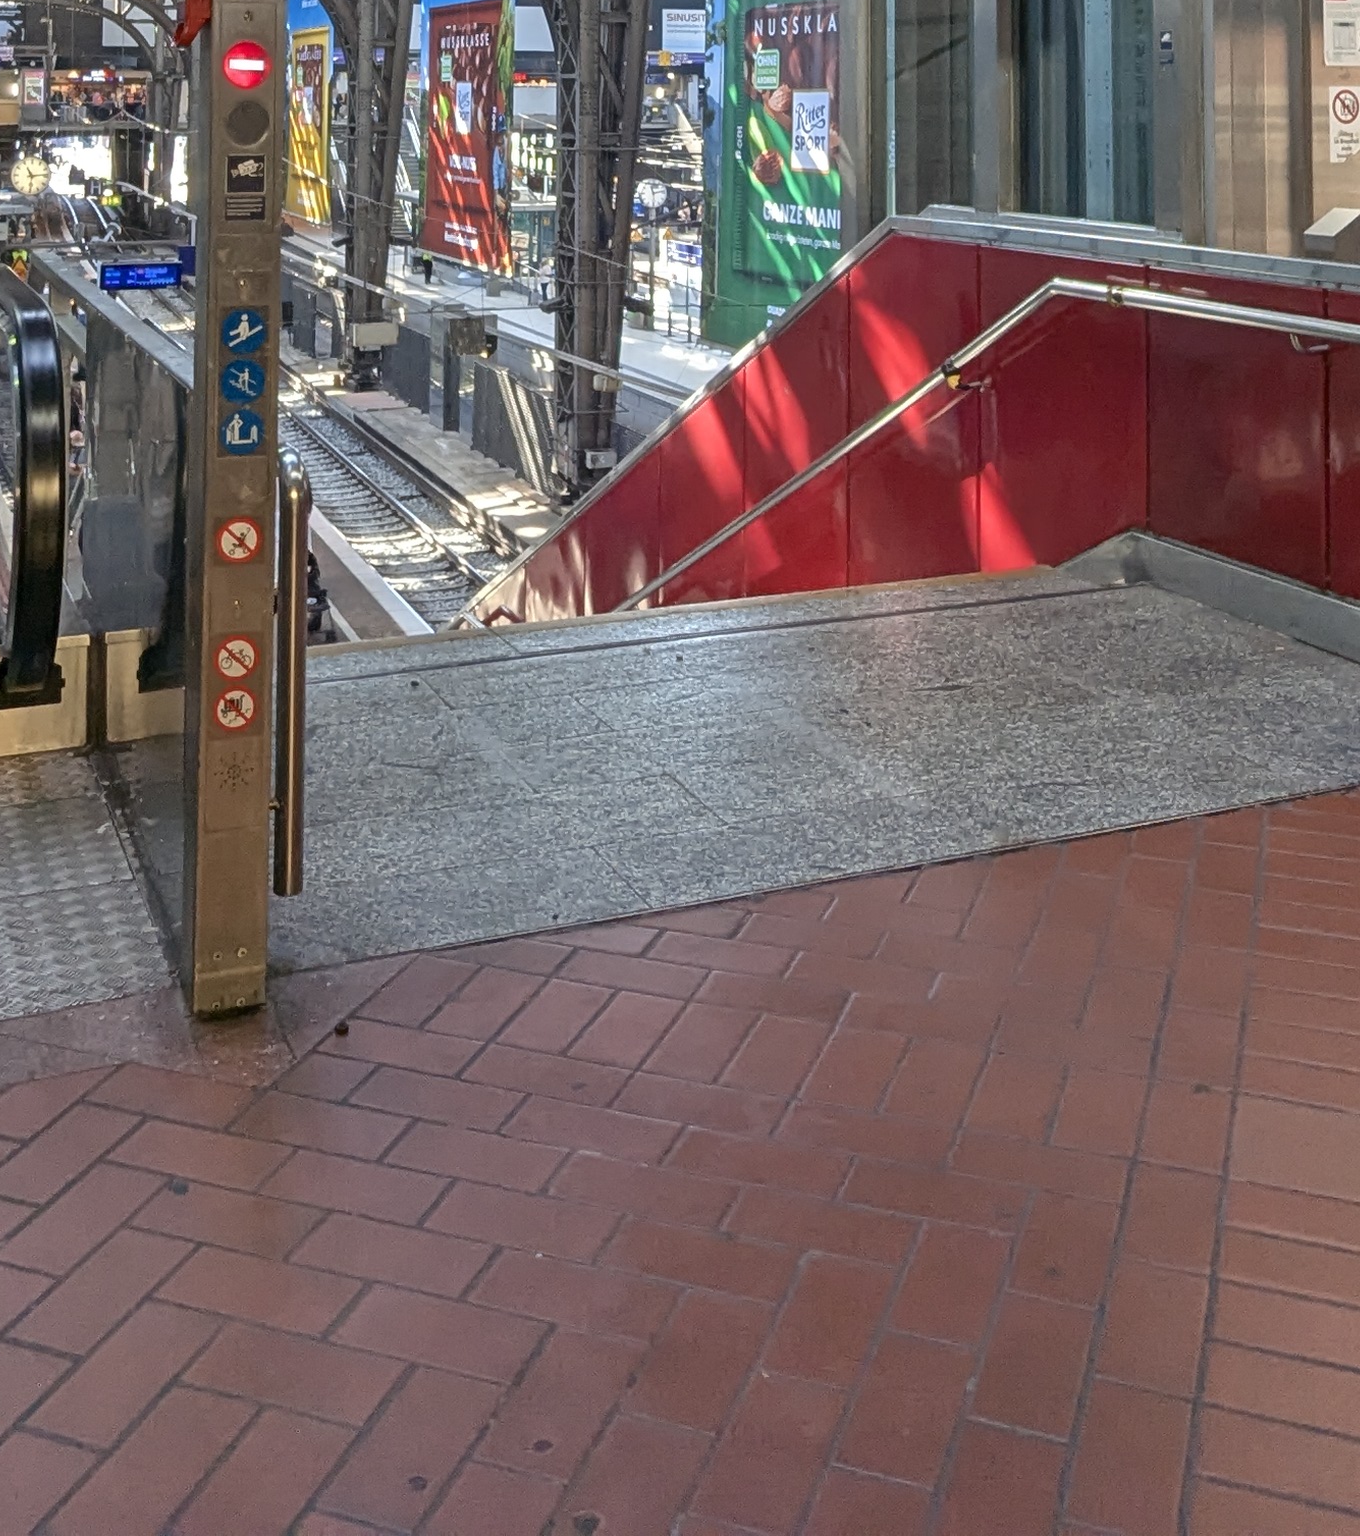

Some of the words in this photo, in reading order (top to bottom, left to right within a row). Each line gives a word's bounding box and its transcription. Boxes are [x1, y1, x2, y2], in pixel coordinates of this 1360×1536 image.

[754, 13, 837, 36] NUSSKLA
[757, 54, 777, 67] OHNE
[795, 102, 826, 133] Ritter
[795, 136, 826, 152] SPORT
